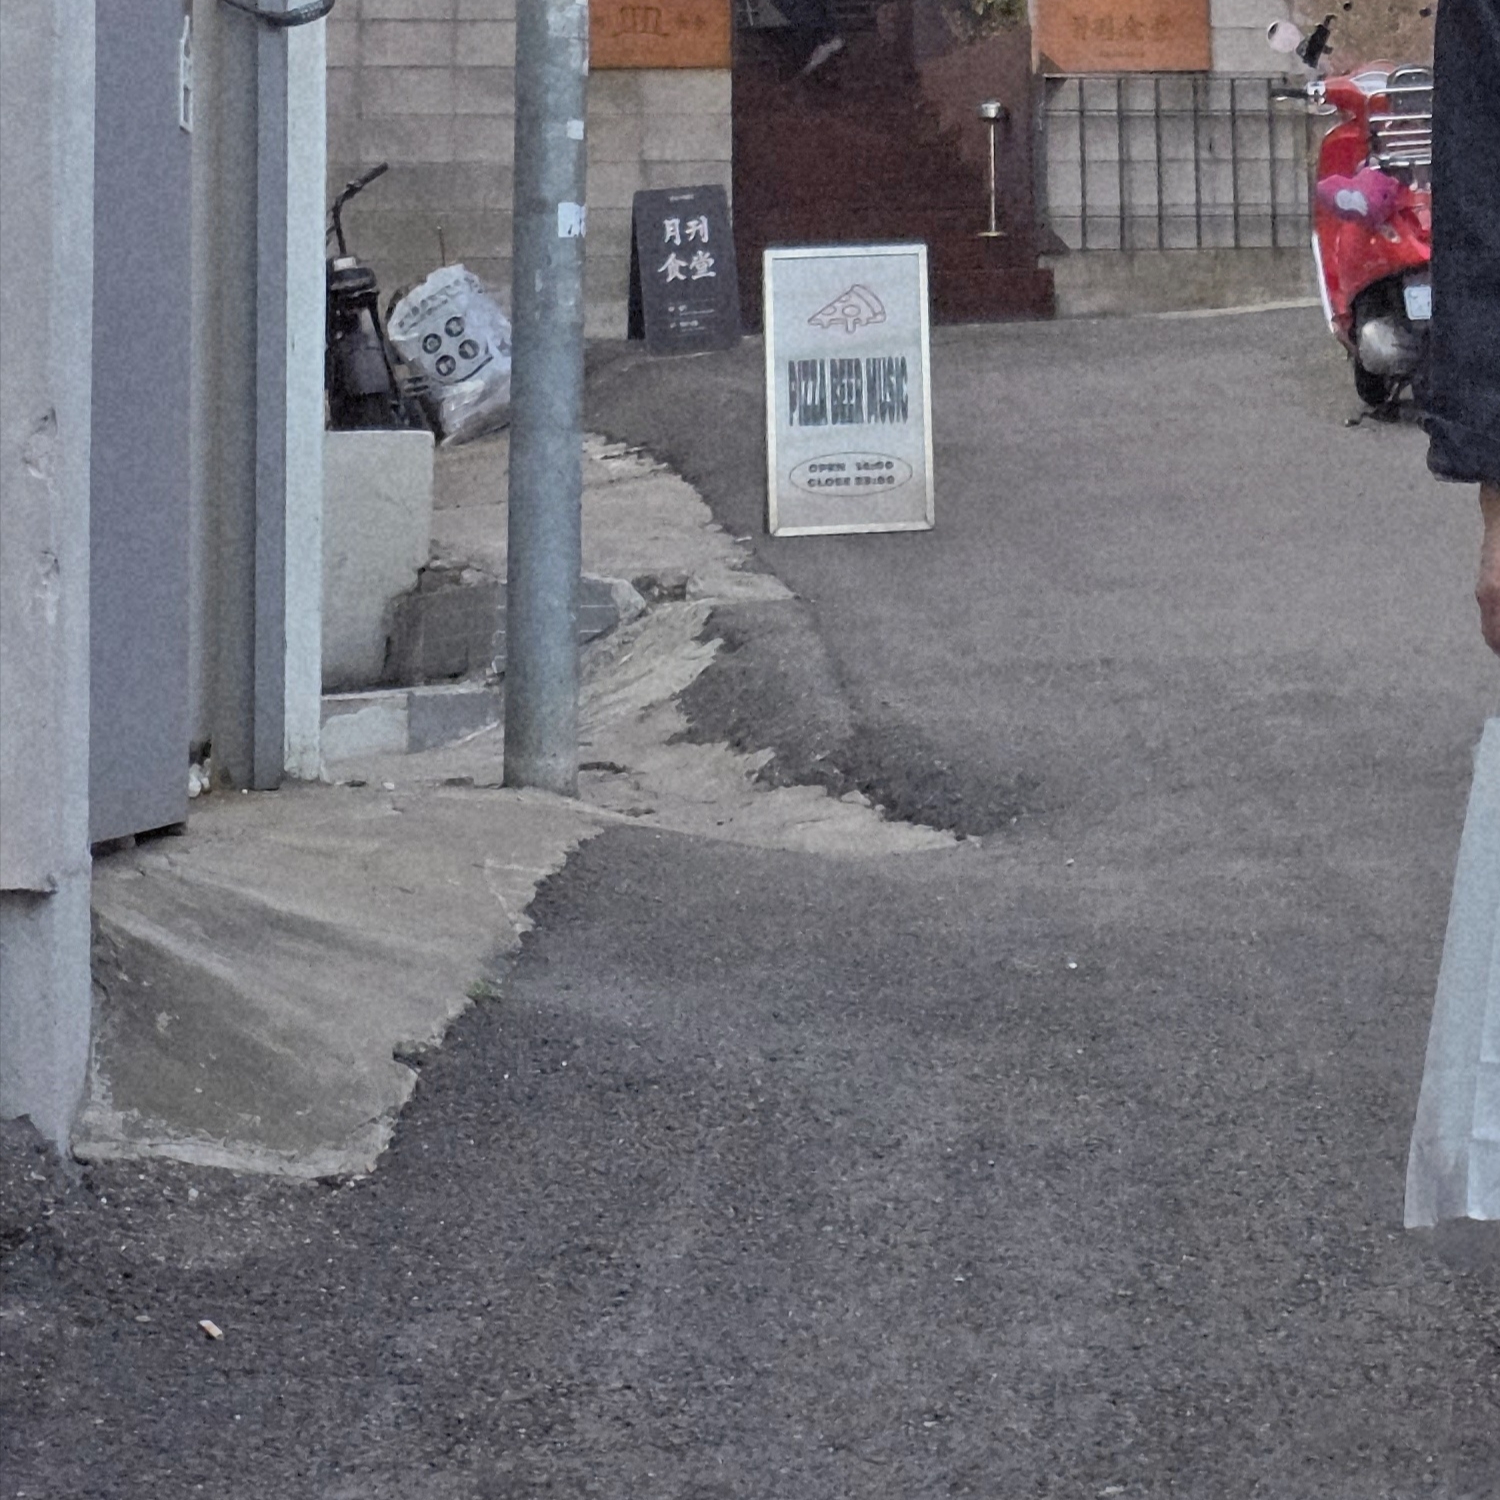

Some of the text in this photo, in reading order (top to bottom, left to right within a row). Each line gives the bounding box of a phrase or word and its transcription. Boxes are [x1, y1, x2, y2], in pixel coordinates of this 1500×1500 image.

[663, 215, 709, 246] 月刊
[658, 250, 716, 282] 食堂
[788, 356, 908, 427] PIZZA BEER MUSIC
[807, 477, 851, 487] CLOSE
[808, 463, 846, 473] OPEN
